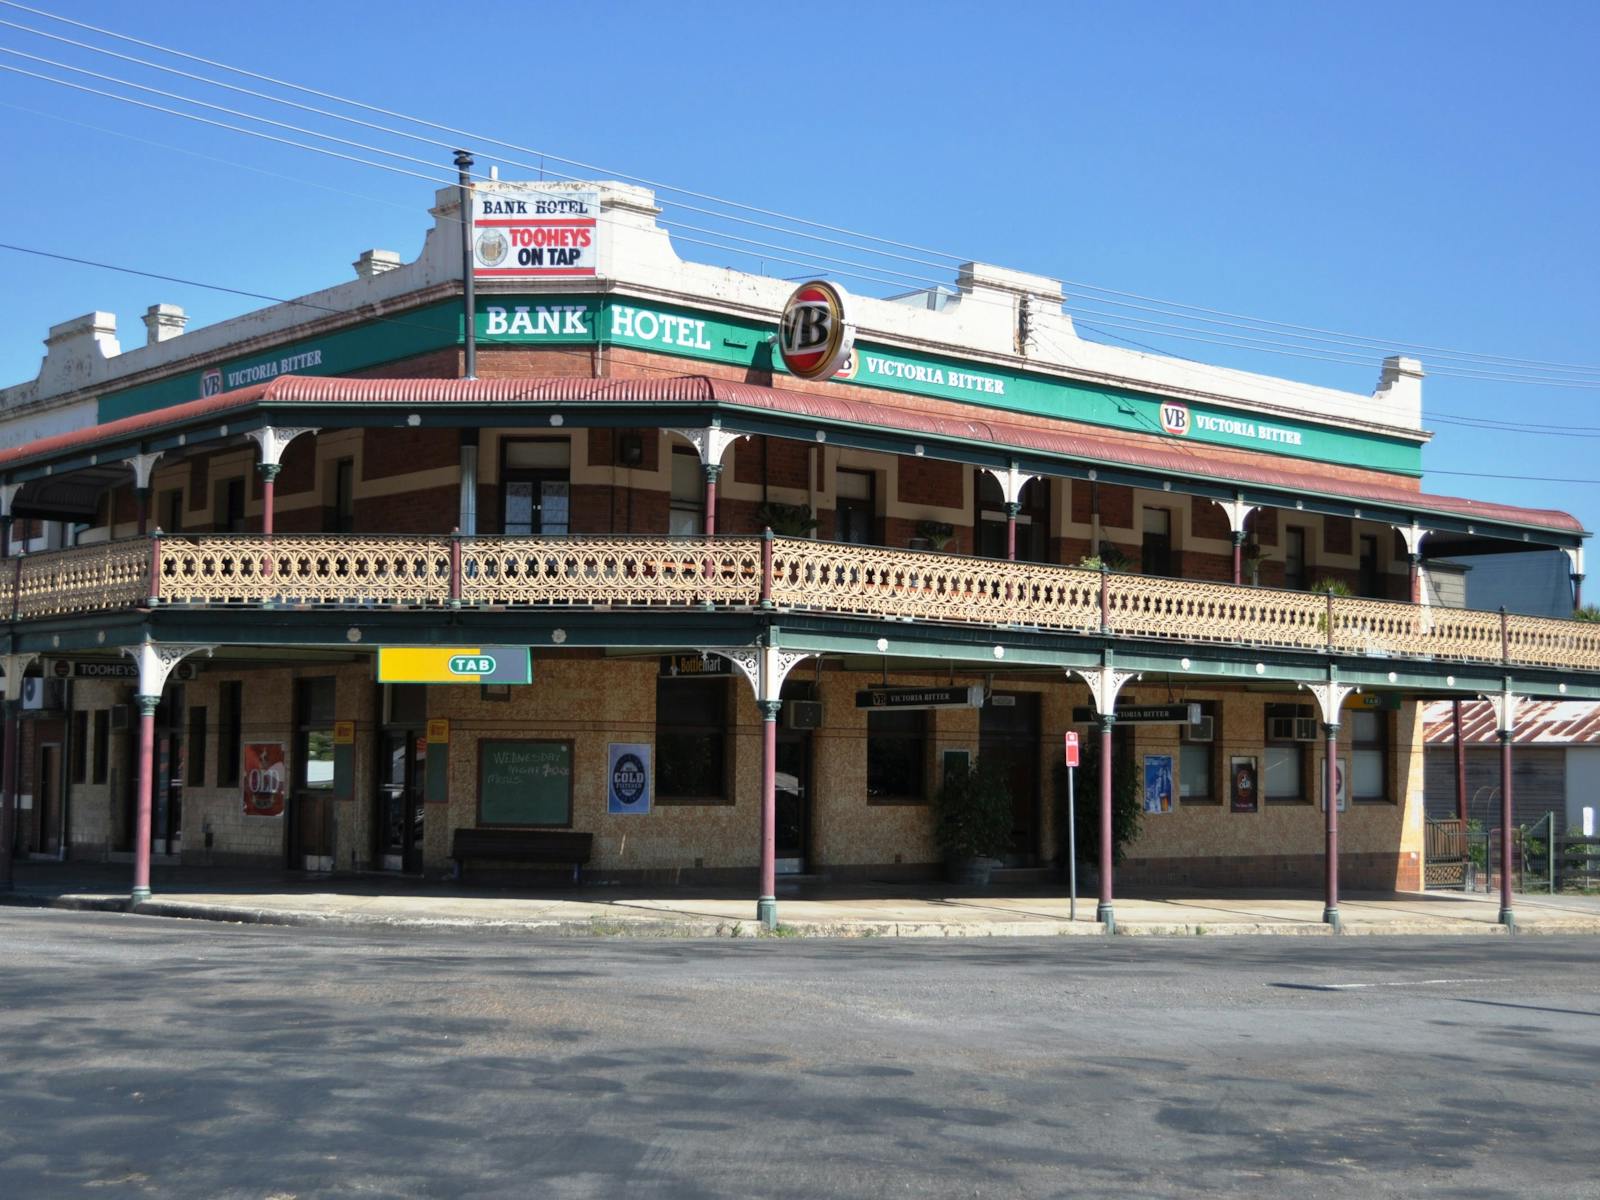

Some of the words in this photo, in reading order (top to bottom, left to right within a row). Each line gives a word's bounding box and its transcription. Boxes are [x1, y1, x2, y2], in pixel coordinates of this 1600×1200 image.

[483, 200, 527, 214] BANK
[535, 200, 588, 214] HOTEL
[509, 228, 591, 247] TOOHEYS
[517, 248, 548, 266] ON
[549, 248, 581, 266] TAP
[486, 306, 588, 335] BANK
[611, 304, 711, 350] HOTEL
[783, 304, 832, 350] VB
[203, 375, 220, 397] VB
[228, 361, 278, 387] VICTORIA
[280, 350, 322, 373] BITTER
[866, 356, 944, 385] VICTORIA
[947, 371, 1005, 395] BITTER
[1164, 408, 1186, 428] VB
[1195, 414, 1256, 438] VICTORIA
[1258, 425, 1302, 445] BITTER
[80, 664, 138, 676] TOOHEYS
[455, 659, 490, 671] TAB
[680, 655, 721, 673] Bottlemart
[890, 694, 922, 703] VICTORIA
[924, 692, 950, 701] BITTER
[1143, 710, 1170, 718] BITTER
[249, 769, 280, 793] OLD
[614, 772, 644, 783] COLD
